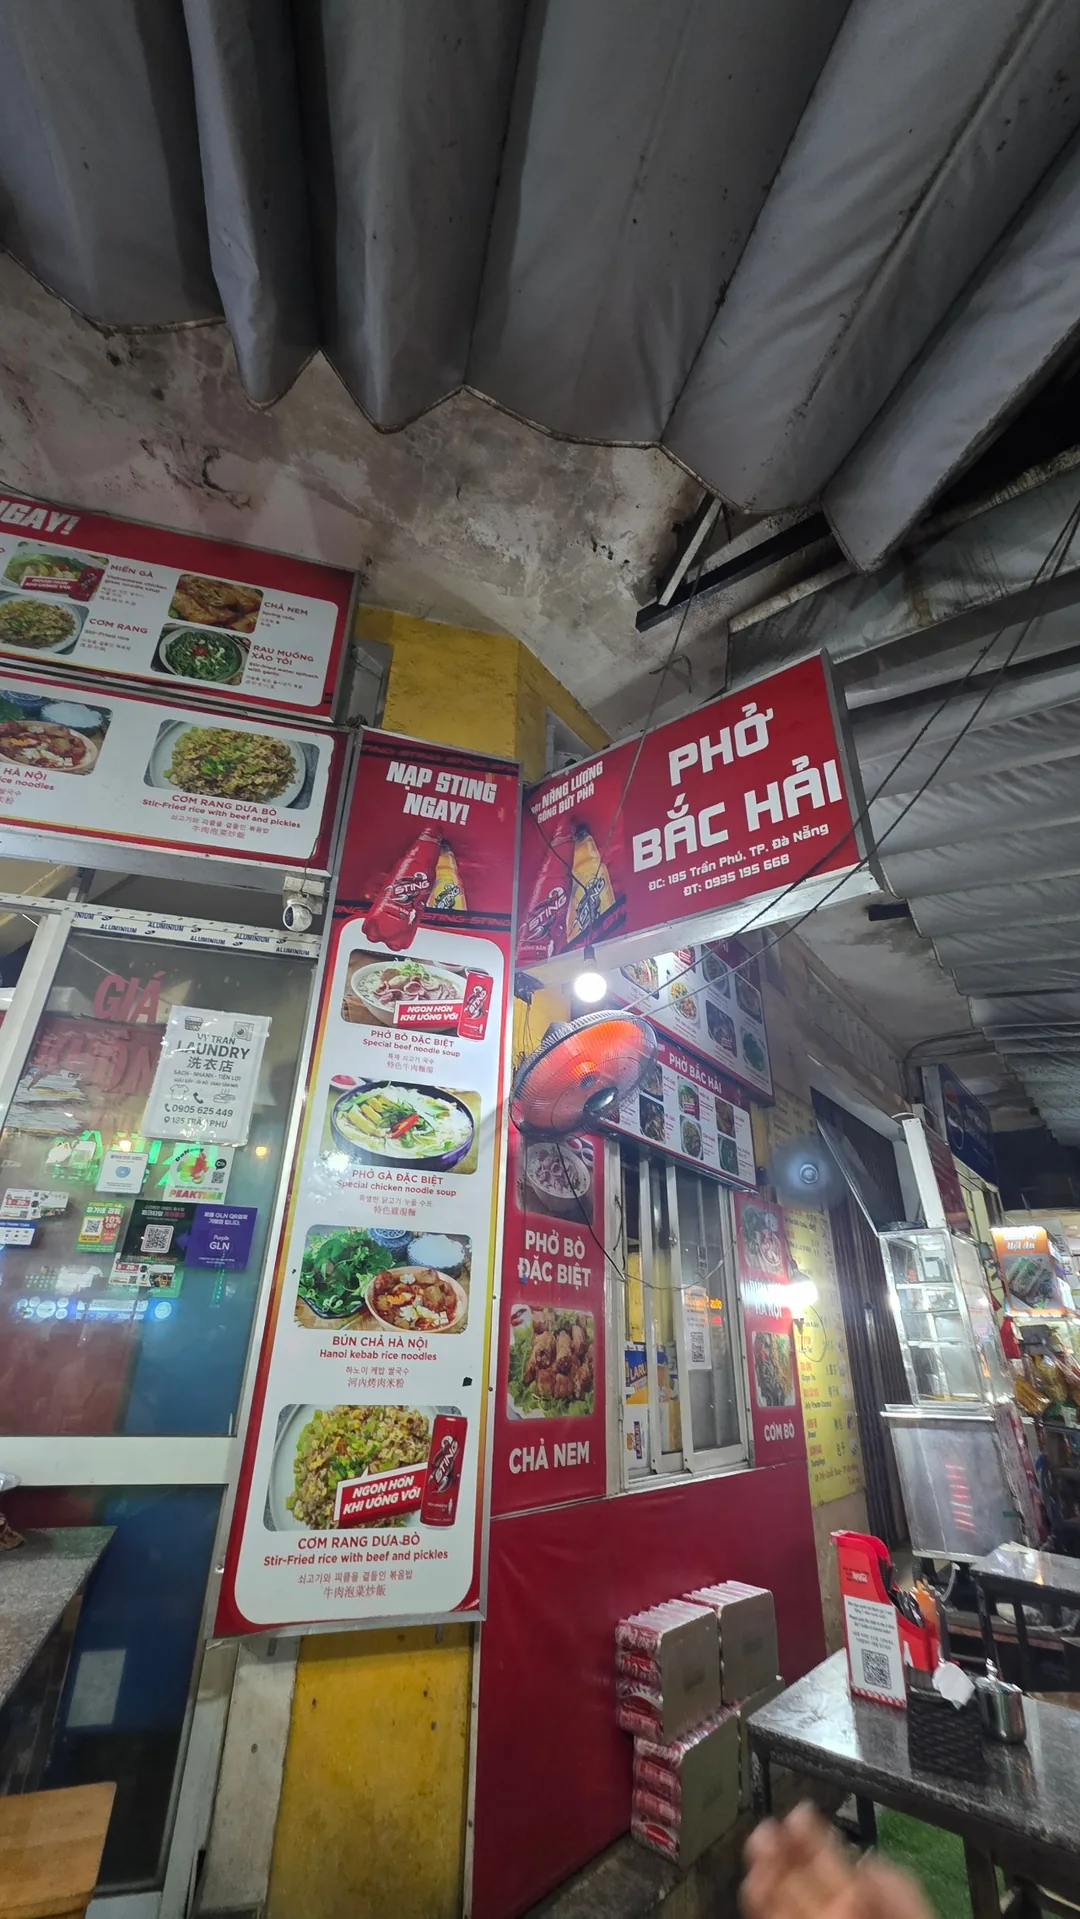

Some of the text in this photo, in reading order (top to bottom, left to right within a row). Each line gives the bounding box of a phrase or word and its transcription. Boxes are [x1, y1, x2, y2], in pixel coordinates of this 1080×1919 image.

[287, 606, 308, 616] NEM
[117, 623, 148, 634] RANG
[253, 645, 274, 654] RAU
[668, 701, 774, 787] PHỞ
[3, 767, 47, 781] HÀ NỘI
[386, 761, 498, 804] NẠP STING
[15, 780, 54, 790] noodles
[542, 760, 603, 808] NĂNG LƯỢNG
[142, 799, 301, 829] Stir-Fried rice with beef and pickles
[172, 794, 277, 817] CƠM RANG DƯA BÒ
[403, 793, 470, 826] NGAY!
[632, 755, 843, 873] BẮC HẢI
[668, 870, 687, 885] 185
[689, 860, 717, 878] Trần
[749, 843, 769, 857] TP.
[771, 835, 790, 850] Đà
[792, 823, 829, 843] Nẵng
[705, 871, 736, 890] 0935
[739, 863, 760, 878] 195
[763, 853, 790, 870] 668
[394, 880, 430, 895] STING
[437, 884, 461, 909] STING
[528, 894, 567, 931] STING
[100, 923, 138, 934] ALUMINIUM
[147, 921, 185, 932] ALUMINIUM
[189, 935, 226, 945] ALUMINIUM
[234, 933, 270, 943] ALUMINIUM
[276, 946, 310, 956] ALUMINIUM
[93, 970, 167, 1024] GIÁ
[400, 1013, 416, 1021] KHI
[407, 1005, 433, 1013] NGON
[212, 1035, 236, 1045] TRAN
[371, 1029, 455, 1048] PHỞ BÒ ĐẶC BIỆT
[176, 1040, 251, 1060] LAUNDRY
[362, 1038, 461, 1058] Special beef noodle soup
[187, 1056, 234, 1073] 洗衣店
[669, 1052, 722, 1094] PHỞ BẮC HẢI
[171, 1104, 234, 1117] 0905 625 449
[209, 1119, 229, 1129] PHÚ
[352, 1168, 444, 1187] PHỞ GÀ ĐẶC BIỆT
[169, 1189, 224, 1200] PEAKTIME
[337, 1179, 457, 1197] Special chicken noodle soup
[105, 1216, 122, 1224] 10%
[209, 1241, 230, 1251] GLN
[213, 1234, 230, 1242] Purple
[525, 1229, 585, 1260] PHỞ BÒ
[517, 1254, 592, 1290] ĐẶC BIỆT
[332, 1334, 428, 1351] BÚN CHẢ HÀ NỘI
[319, 1349, 437, 1361] Hanoi kebab rice noodles
[345, 1366, 368, 1375] 하노이
[630, 1362, 647, 1382] LARU
[764, 1420, 796, 1442] CƠM BÒ
[434, 1440, 459, 1483] STING
[508, 1437, 590, 1475] CHẢ NEM
[352, 1481, 387, 1499] NGON
[342, 1500, 365, 1515] KHI
[365, 1492, 400, 1509] UỐNG
[298, 1532, 421, 1550] CƠM RANG DƯA BÒ
[263, 1549, 448, 1567] Stir-Fried rice with beef and pickles
[298, 1572, 331, 1585] 쇠고기와
